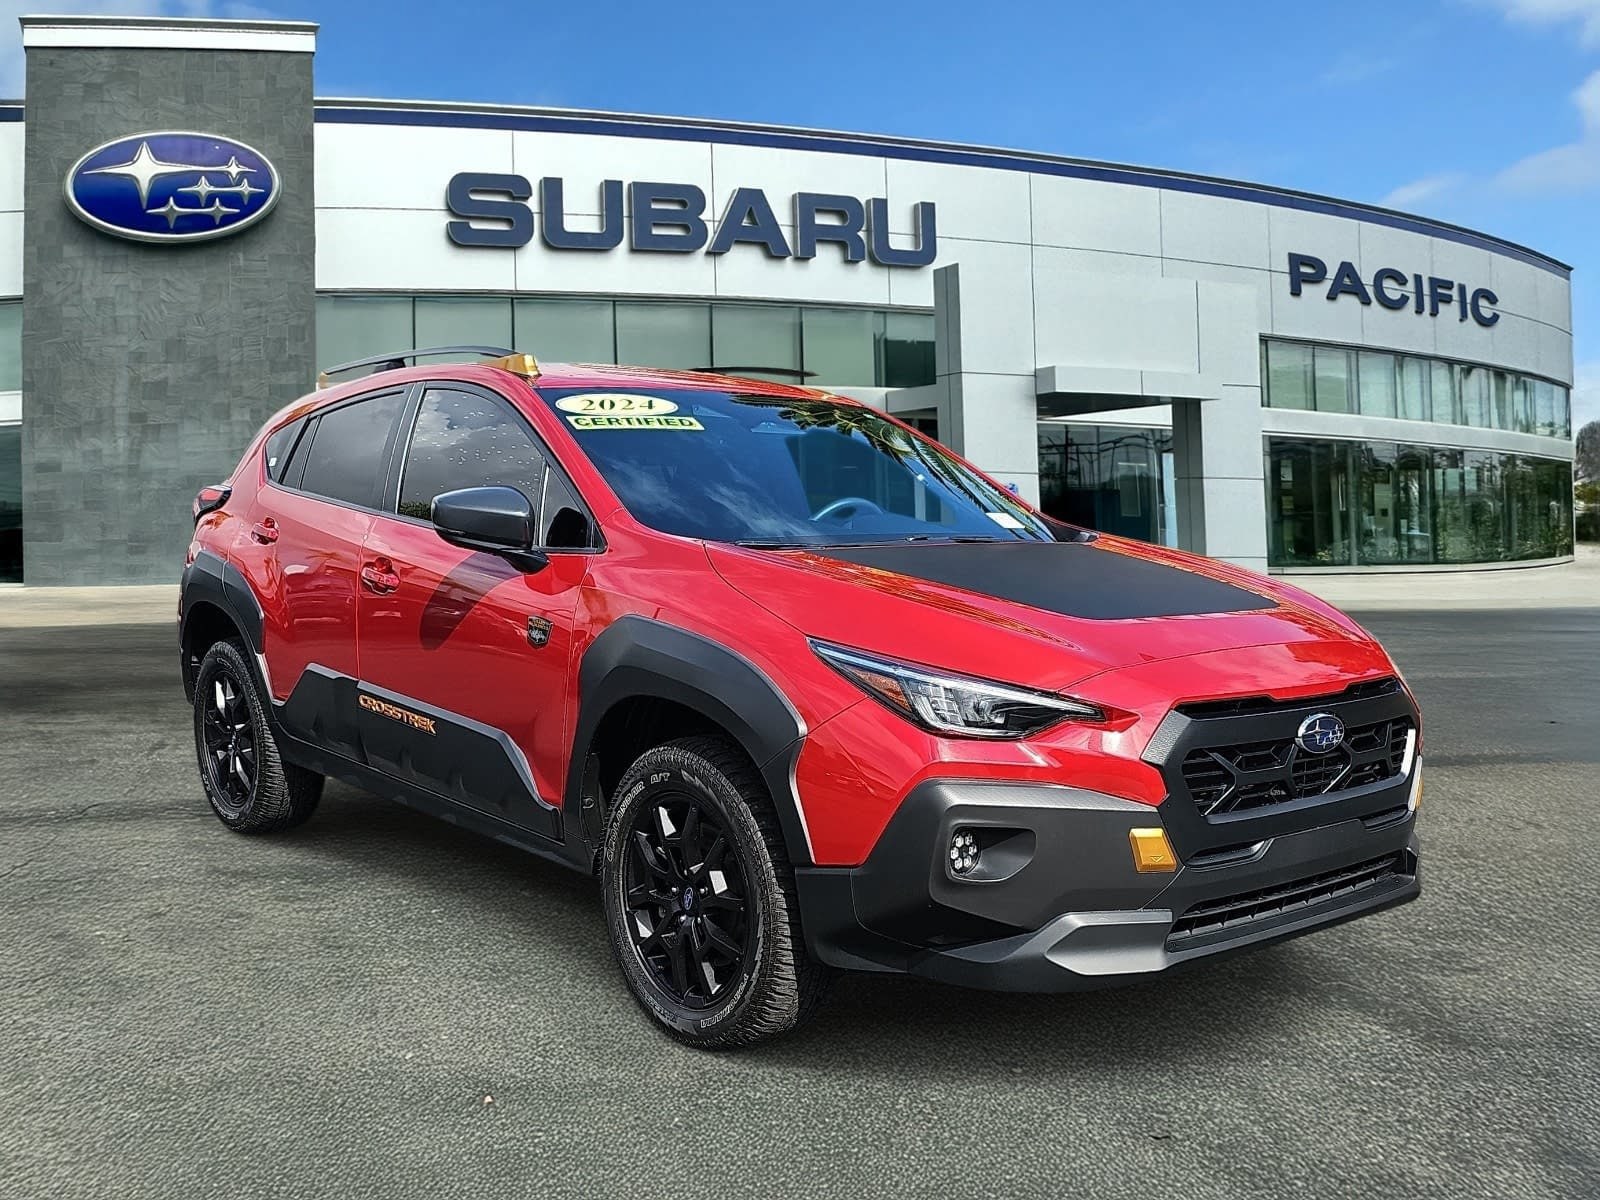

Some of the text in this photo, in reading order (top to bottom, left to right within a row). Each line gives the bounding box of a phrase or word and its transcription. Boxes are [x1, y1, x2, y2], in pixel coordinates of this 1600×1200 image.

[446, 171, 938, 268] SUBARU
[1287, 251, 1501, 328] PACIFIC
[574, 416, 694, 427] CERTIFIED
[582, 399, 656, 411] 2024
[357, 693, 437, 736] CROSSTREK
